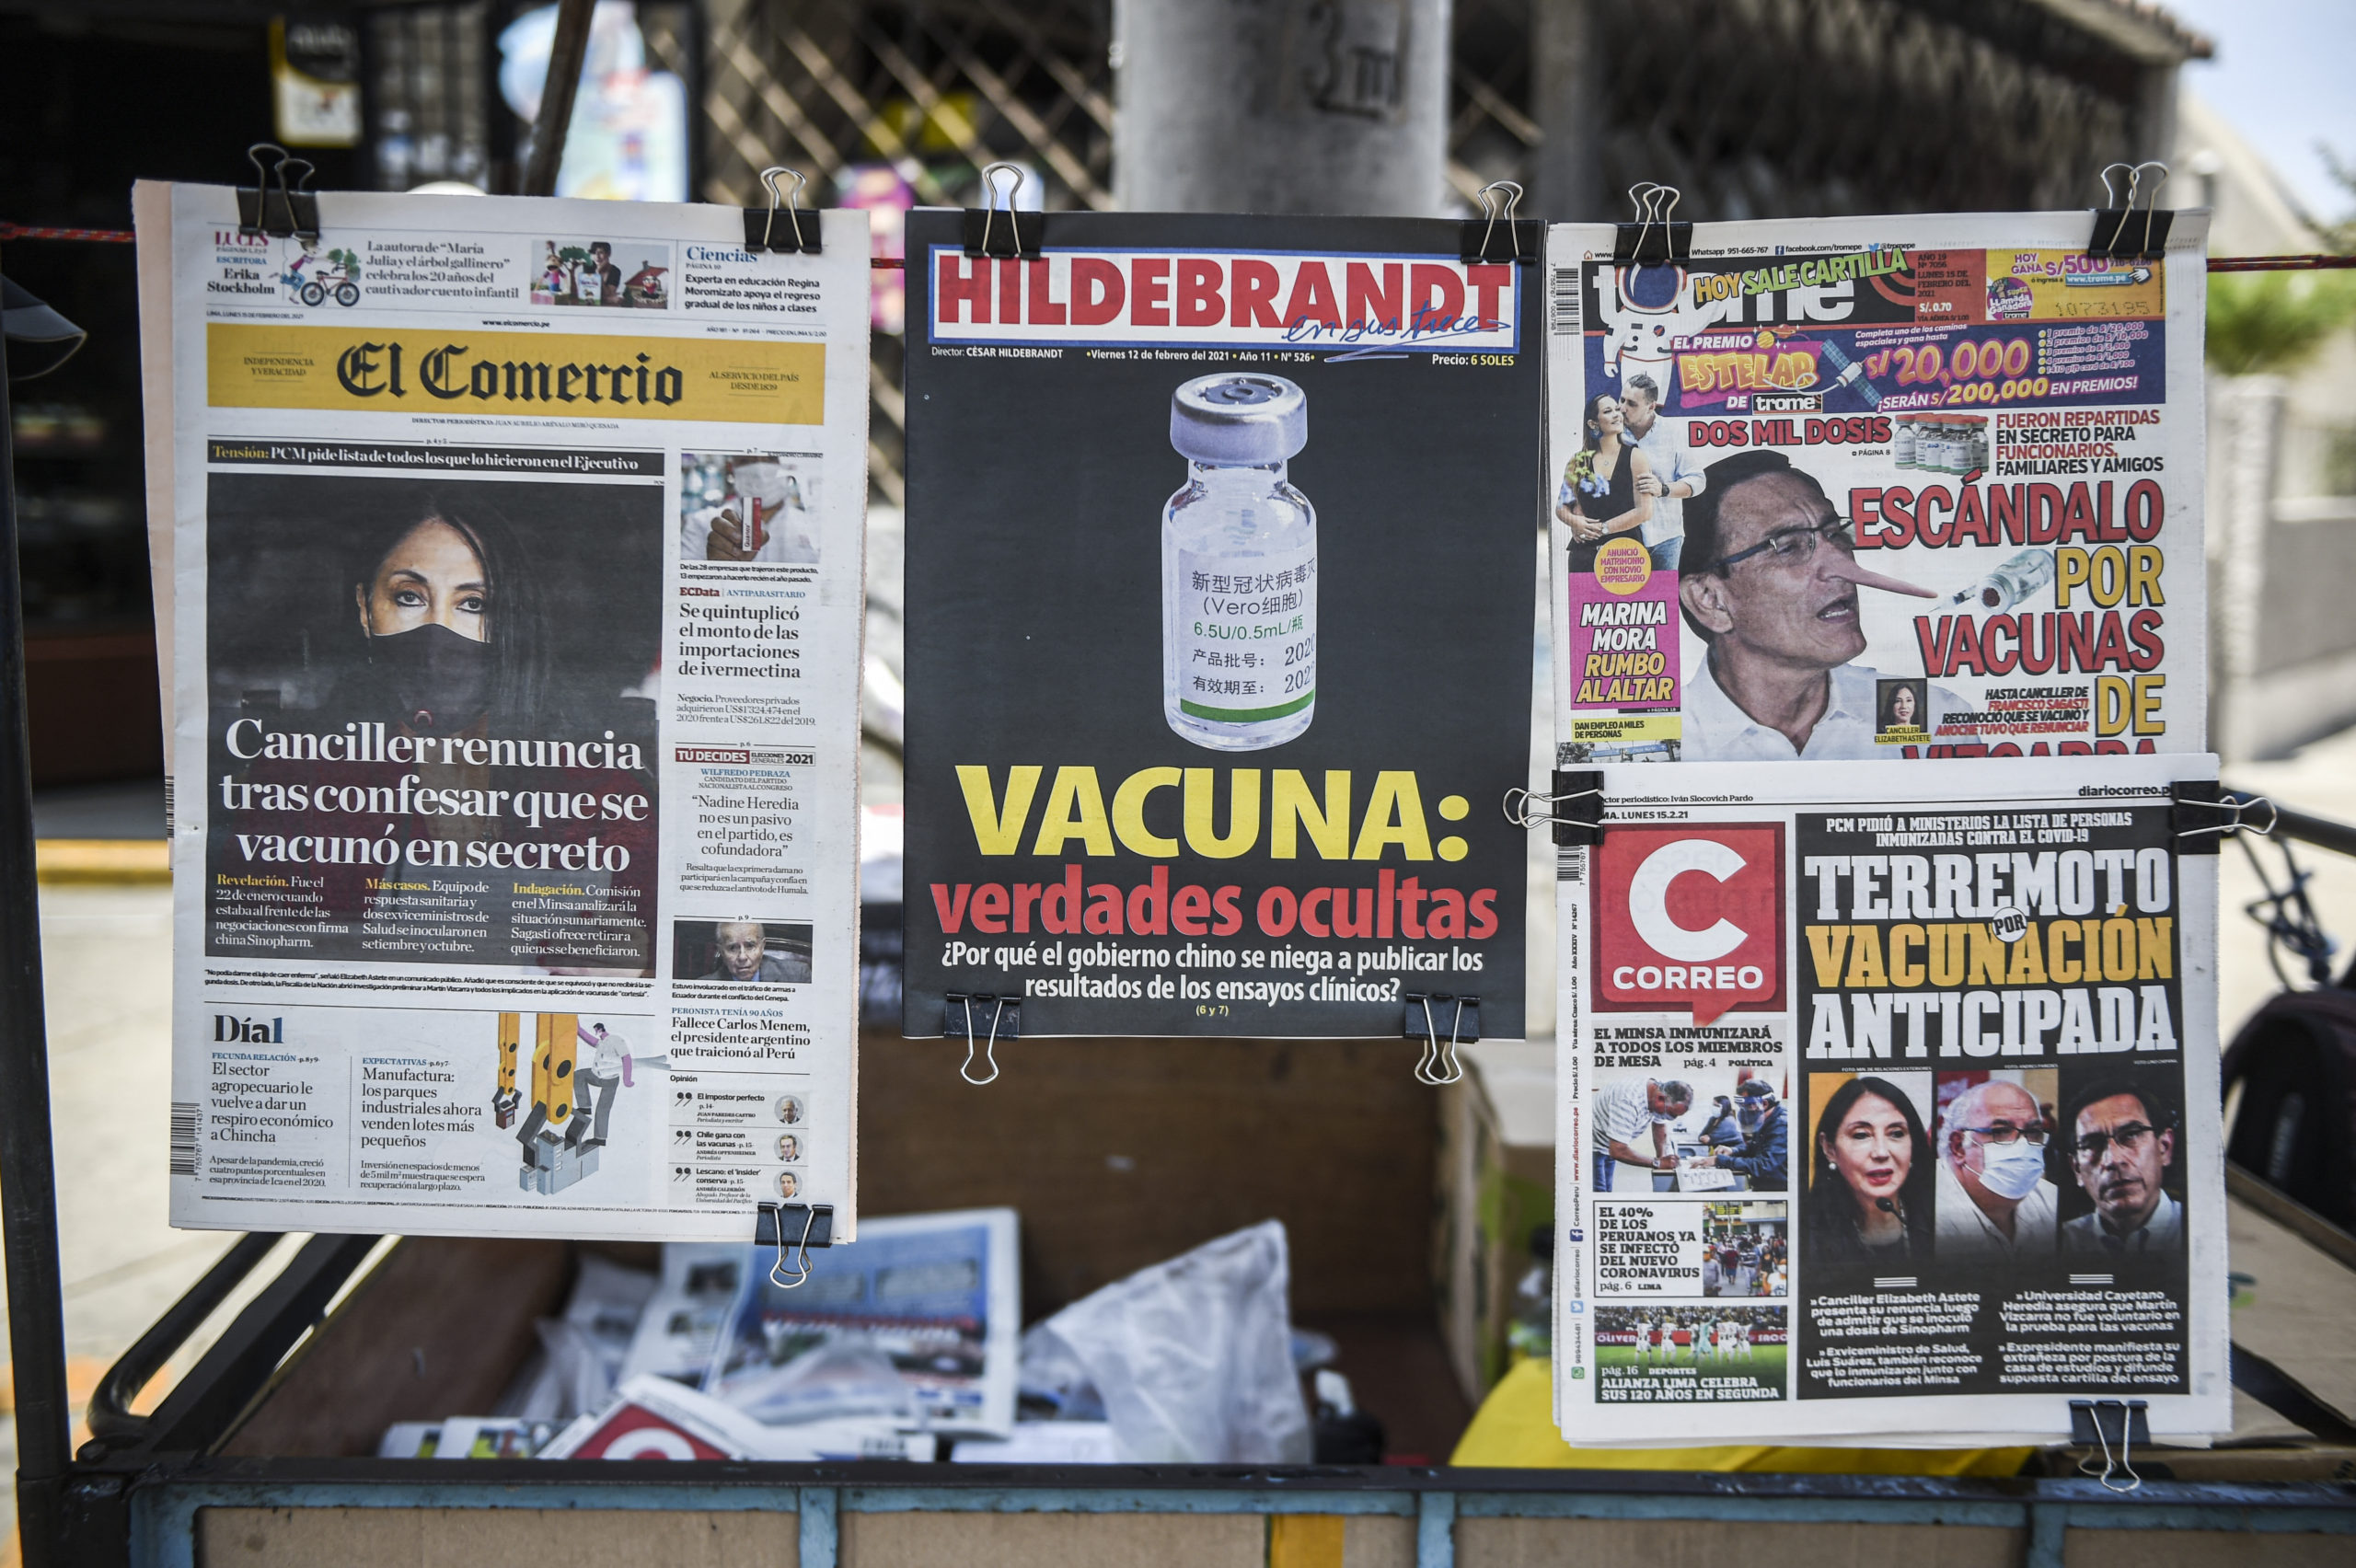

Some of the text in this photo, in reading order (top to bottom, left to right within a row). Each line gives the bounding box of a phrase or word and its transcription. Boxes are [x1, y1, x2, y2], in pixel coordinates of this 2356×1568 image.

[687, 247, 757, 262] Ciencias
[1692, 247, 1768, 256] Whatsapp 951-665-767
[1786, 243, 1862, 253] facebook.com/tromepe
[224, 269, 260, 280] Erika
[685, 274, 721, 285] Experta
[738, 276, 785, 286] educación
[788, 280, 819, 290] Regina
[1694, 248, 1909, 304] HOY SALE CARTILLA
[207, 282, 275, 294] Stockholm
[685, 288, 820, 302] Moromizato apoya el regreso
[938, 254, 1511, 333] HILDEBRANDT
[685, 300, 720, 311] gradual
[736, 302, 750, 310] los
[753, 302, 777, 311] niños
[788, 304, 817, 313] clases
[1673, 335, 1752, 350] EL PREMIO
[932, 346, 1063, 358] Director: CÉSAR HILDEBRANDT
[1091, 350, 1230, 362] Viernes 12 de febrero del 2021
[1240, 352, 1270, 361] Año 11
[1294, 352, 1310, 362] 526
[1432, 354, 1514, 366] Precio: 6 SOLES
[337, 341, 683, 406] El Comercio
[1679, 351, 1818, 391] ESTELAR
[1727, 396, 1816, 411] DE trome
[1996, 410, 2160, 428] FUERON REPARTIDAS
[1690, 417, 1892, 446] DOS MIL DOSIS
[1996, 427, 2135, 444] EN SECRETO PARA
[1996, 456, 2164, 476] FAMILIARES Y AMIGOS
[1849, 468, 2165, 550] ESCÁNDALO
[2054, 545, 2165, 608] POR
[1580, 601, 1667, 628] MARINA
[1592, 628, 1656, 651] MORA
[1913, 608, 2165, 677] VACUNAS
[1585, 652, 1666, 677] RUMBO
[1575, 677, 1674, 703] AL ALTAR
[2095, 674, 2165, 737] DE
[226, 719, 645, 770] Canciller renuncia
[677, 749, 813, 764] TÚ DECIDES 2021
[219, 775, 648, 827] tras confesar que se
[954, 765, 1469, 861] VACUNA:
[1657, 811, 1688, 819] 15.2.21
[1827, 813, 2132, 832] PCM PIDIÓ A MINISTERIOS LA LISTA DE PERSONAS
[1877, 829, 2088, 847] INMUNIZADAS CONTRA EL COVID-19
[236, 824, 629, 870] vacunó en secreto
[1805, 847, 2171, 920] TERREMOTO
[930, 864, 1498, 939] verdades ocultas
[1628, 839, 1749, 963] C
[1994, 913, 2026, 936] POR
[1806, 905, 2172, 987] VACUNACIÓN
[941, 941, 1483, 975] ¿Por qué el gobierno chino se niega a publicar los
[1613, 966, 1763, 990] CORREO
[1026, 974, 1401, 1008] resultados de los ensayos clínicos?
[672, 1017, 810, 1033] Fallece Carlos Menem,
[1806, 986, 2177, 1059] ANTICIPADA
[671, 1032, 810, 1046] el presidente argentino
[1594, 1025, 1772, 1039] EL MINSA INMUNIZARÁ
[671, 1047, 795, 1059] que traicionó al Perú
[1595, 1042, 1782, 1053] A TODOS LOS MIEMBROS
[1595, 1055, 1661, 1066] DE MESA
[1600, 1207, 1653, 1217] EL 40%
[1600, 1219, 1647, 1229] DE LOS
[1600, 1231, 1695, 1241] PERUANOS YA
[1600, 1241, 1680, 1253] SE INFECTÓ
[1600, 1256, 1678, 1265] DEL NUEVO
[1600, 1268, 1700, 1277] CORONAVIRUS
